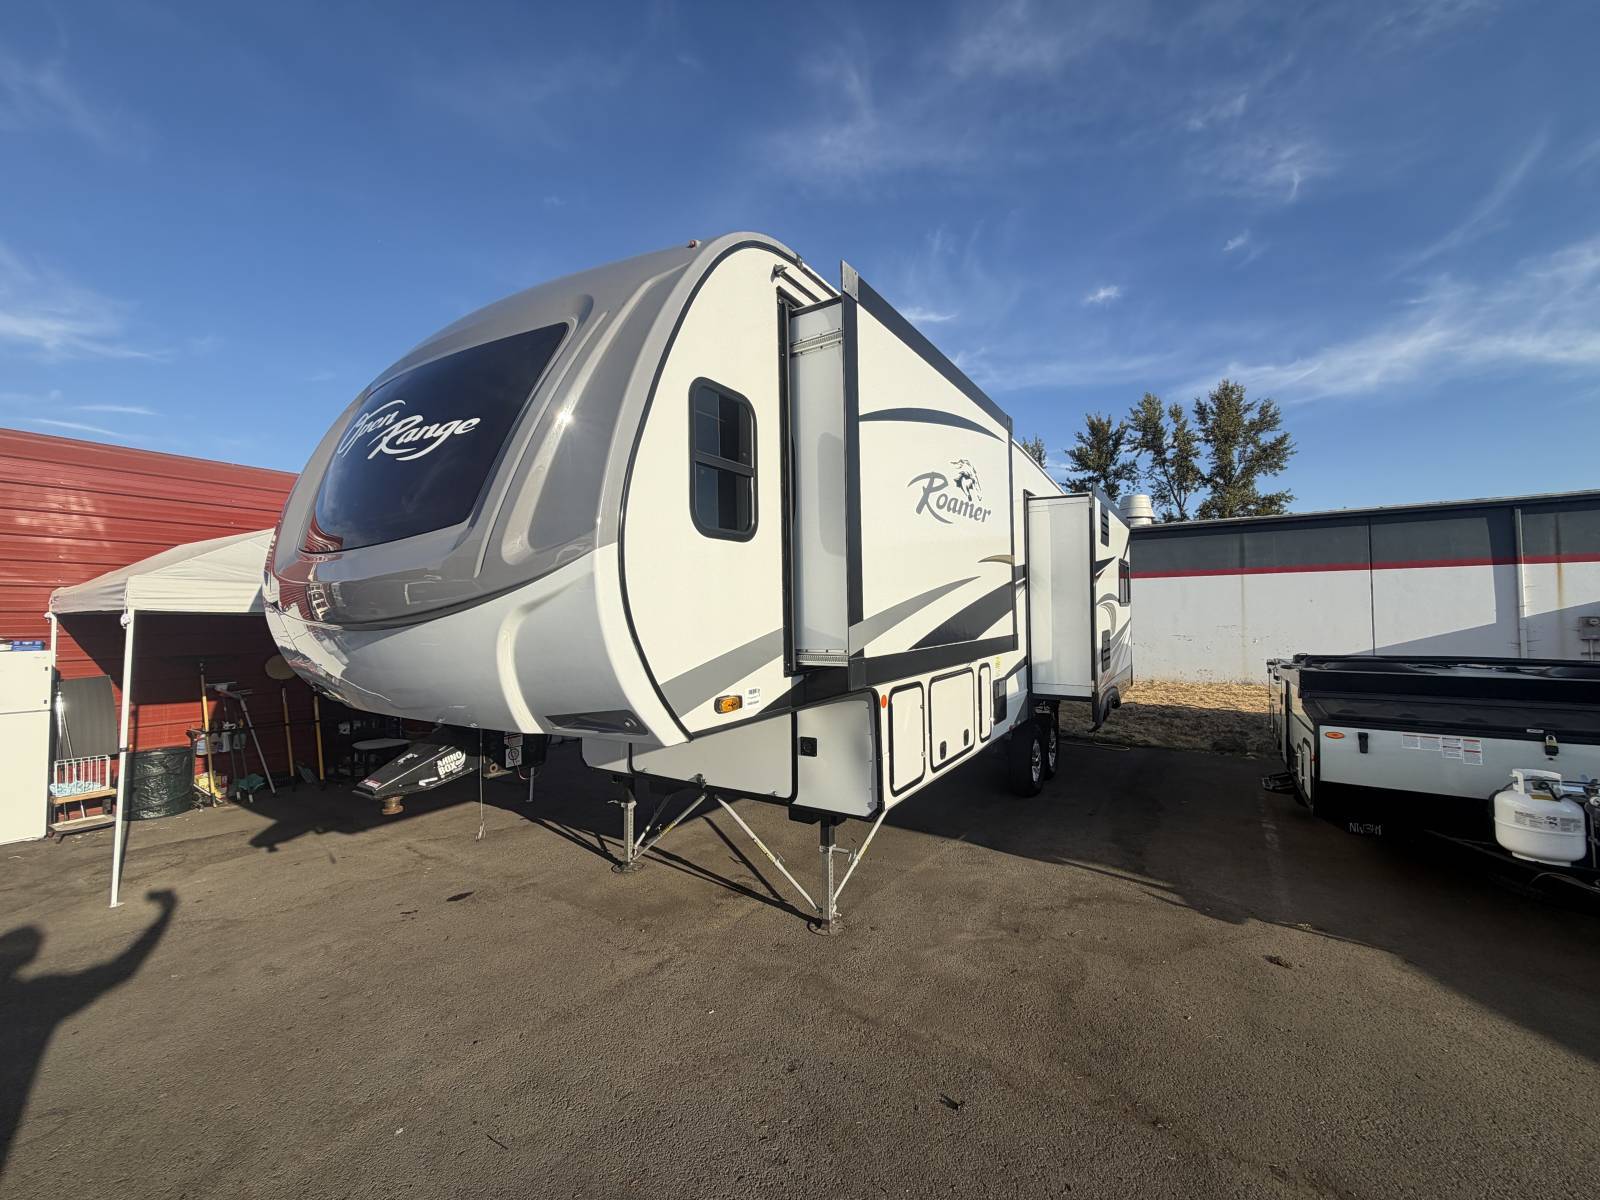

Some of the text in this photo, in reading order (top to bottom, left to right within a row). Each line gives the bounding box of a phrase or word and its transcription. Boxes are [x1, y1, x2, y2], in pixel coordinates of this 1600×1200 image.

[337, 400, 406, 457] Open
[367, 415, 481, 461] Range
[907, 471, 992, 524] Roamer
[438, 762, 457, 776] BOX
